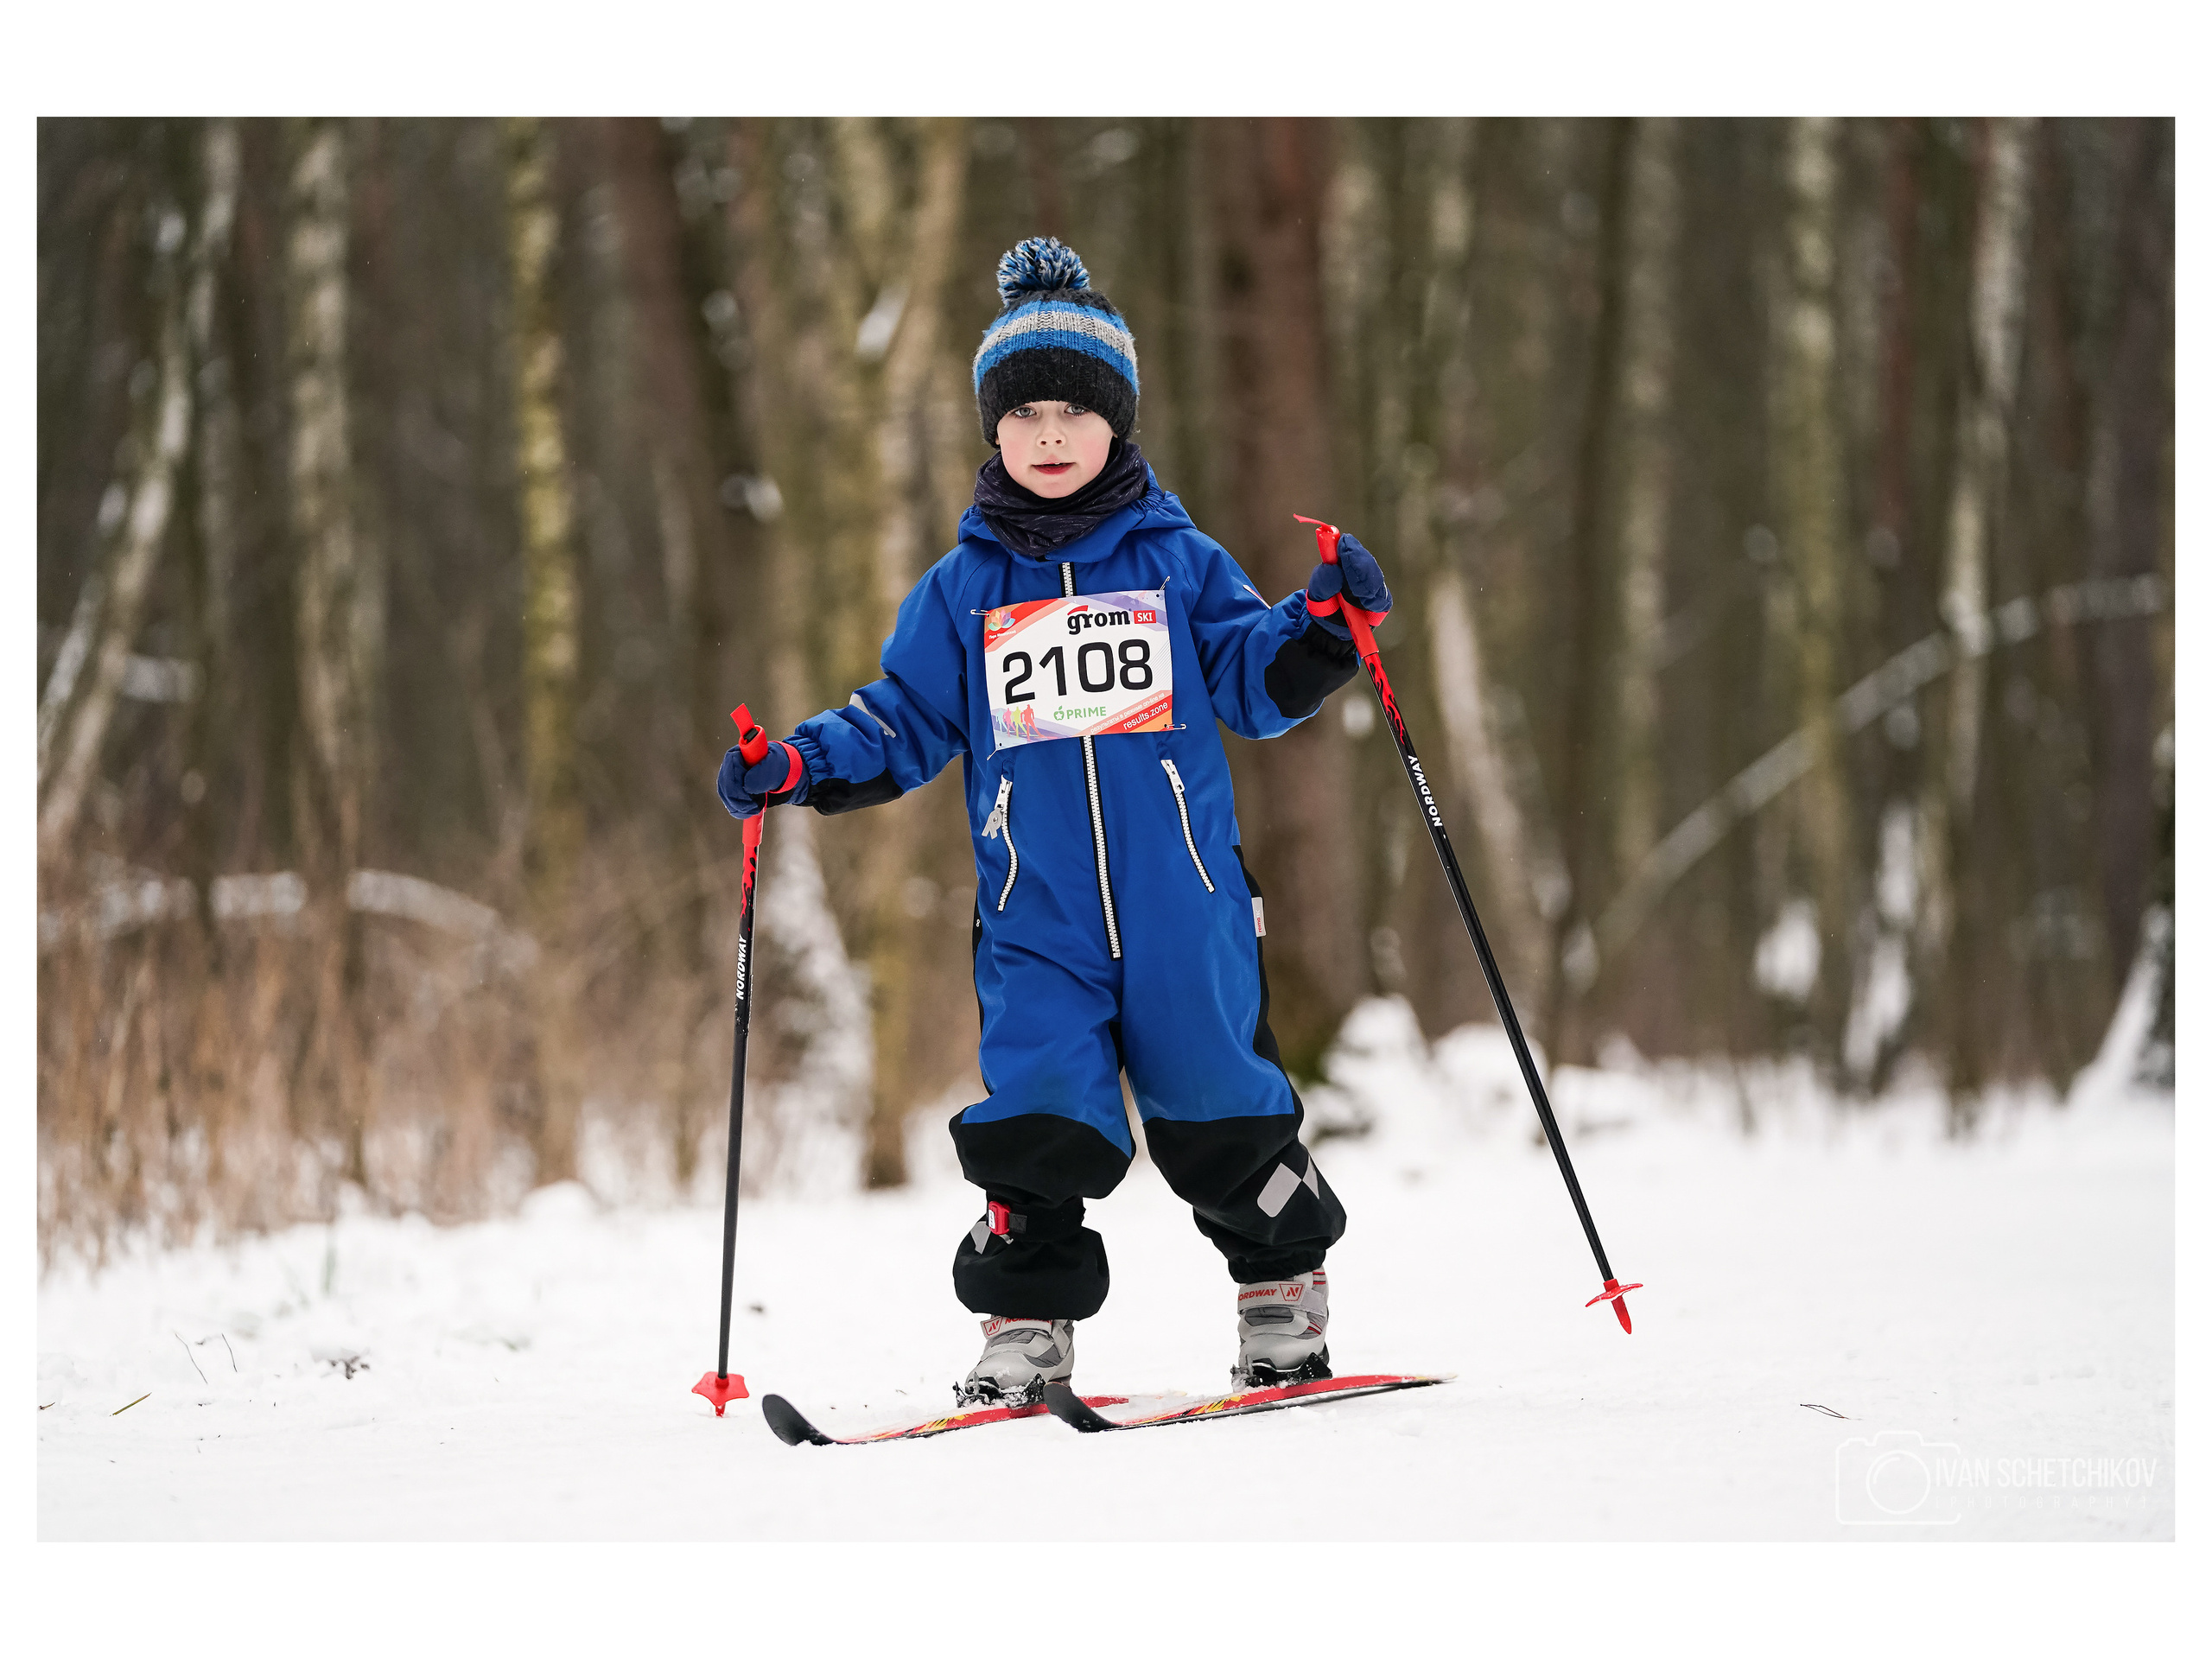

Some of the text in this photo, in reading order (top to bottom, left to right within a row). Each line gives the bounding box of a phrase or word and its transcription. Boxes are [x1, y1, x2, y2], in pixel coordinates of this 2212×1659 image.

[1067, 610, 1154, 635] grom SKI
[1002, 639, 1153, 704] 2108
[1066, 706, 1107, 720] PRIME
[1122, 702, 1168, 730] results.zone
[1408, 755, 1443, 827] NORDWAY
[735, 933, 747, 1000] NORDWAY
[1237, 1288, 1277, 1301] ORDWAY
